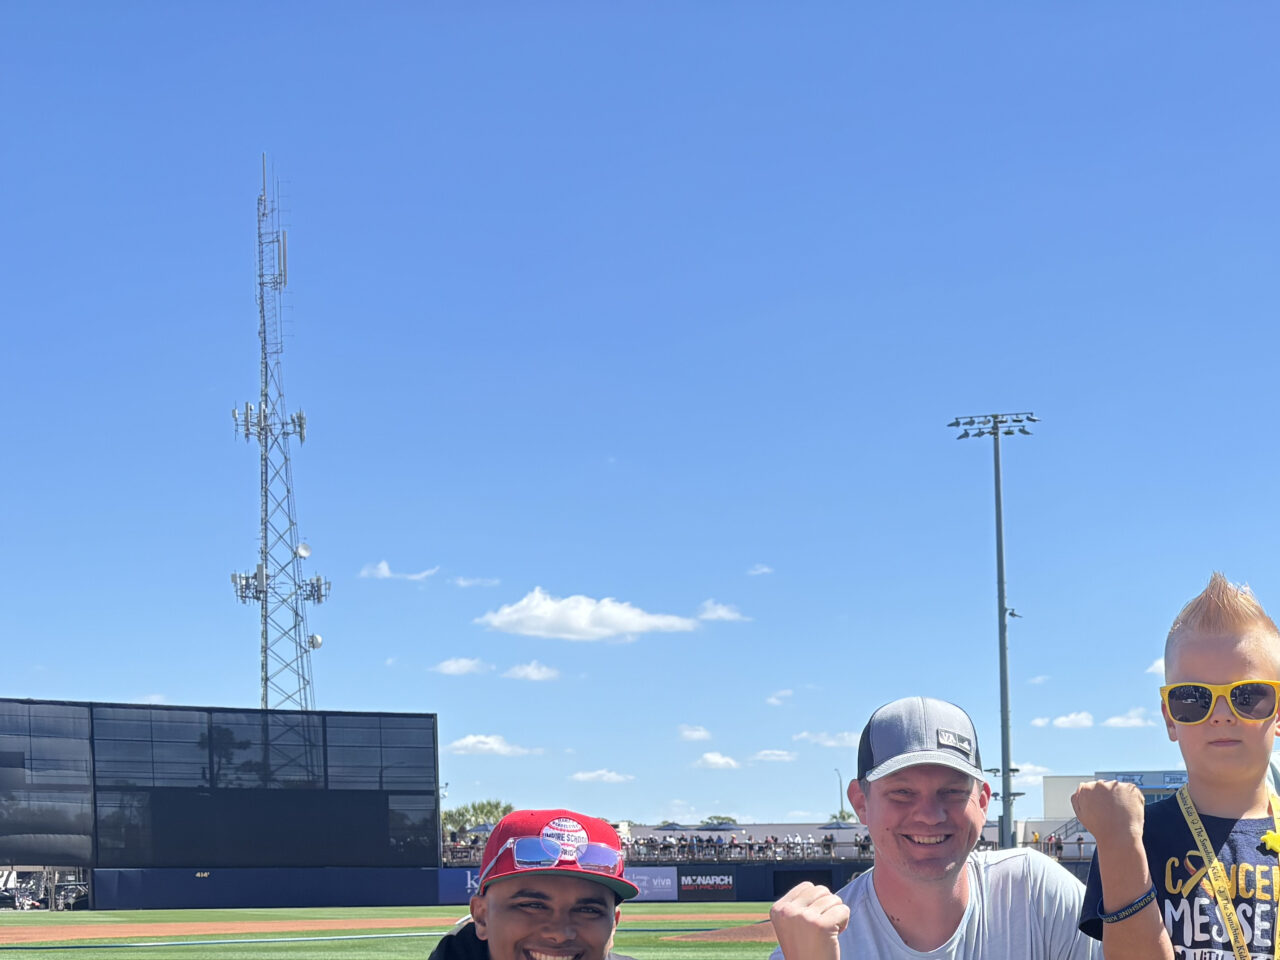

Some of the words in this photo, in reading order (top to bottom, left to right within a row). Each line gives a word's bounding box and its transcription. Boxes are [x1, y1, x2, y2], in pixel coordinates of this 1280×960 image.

[1194, 826, 1204, 838] The
[1200, 837, 1214, 865] Sunshine
[1211, 865, 1221, 882] Kids
[1220, 896, 1230, 911] The
[1226, 912, 1240, 944] Sunshine
